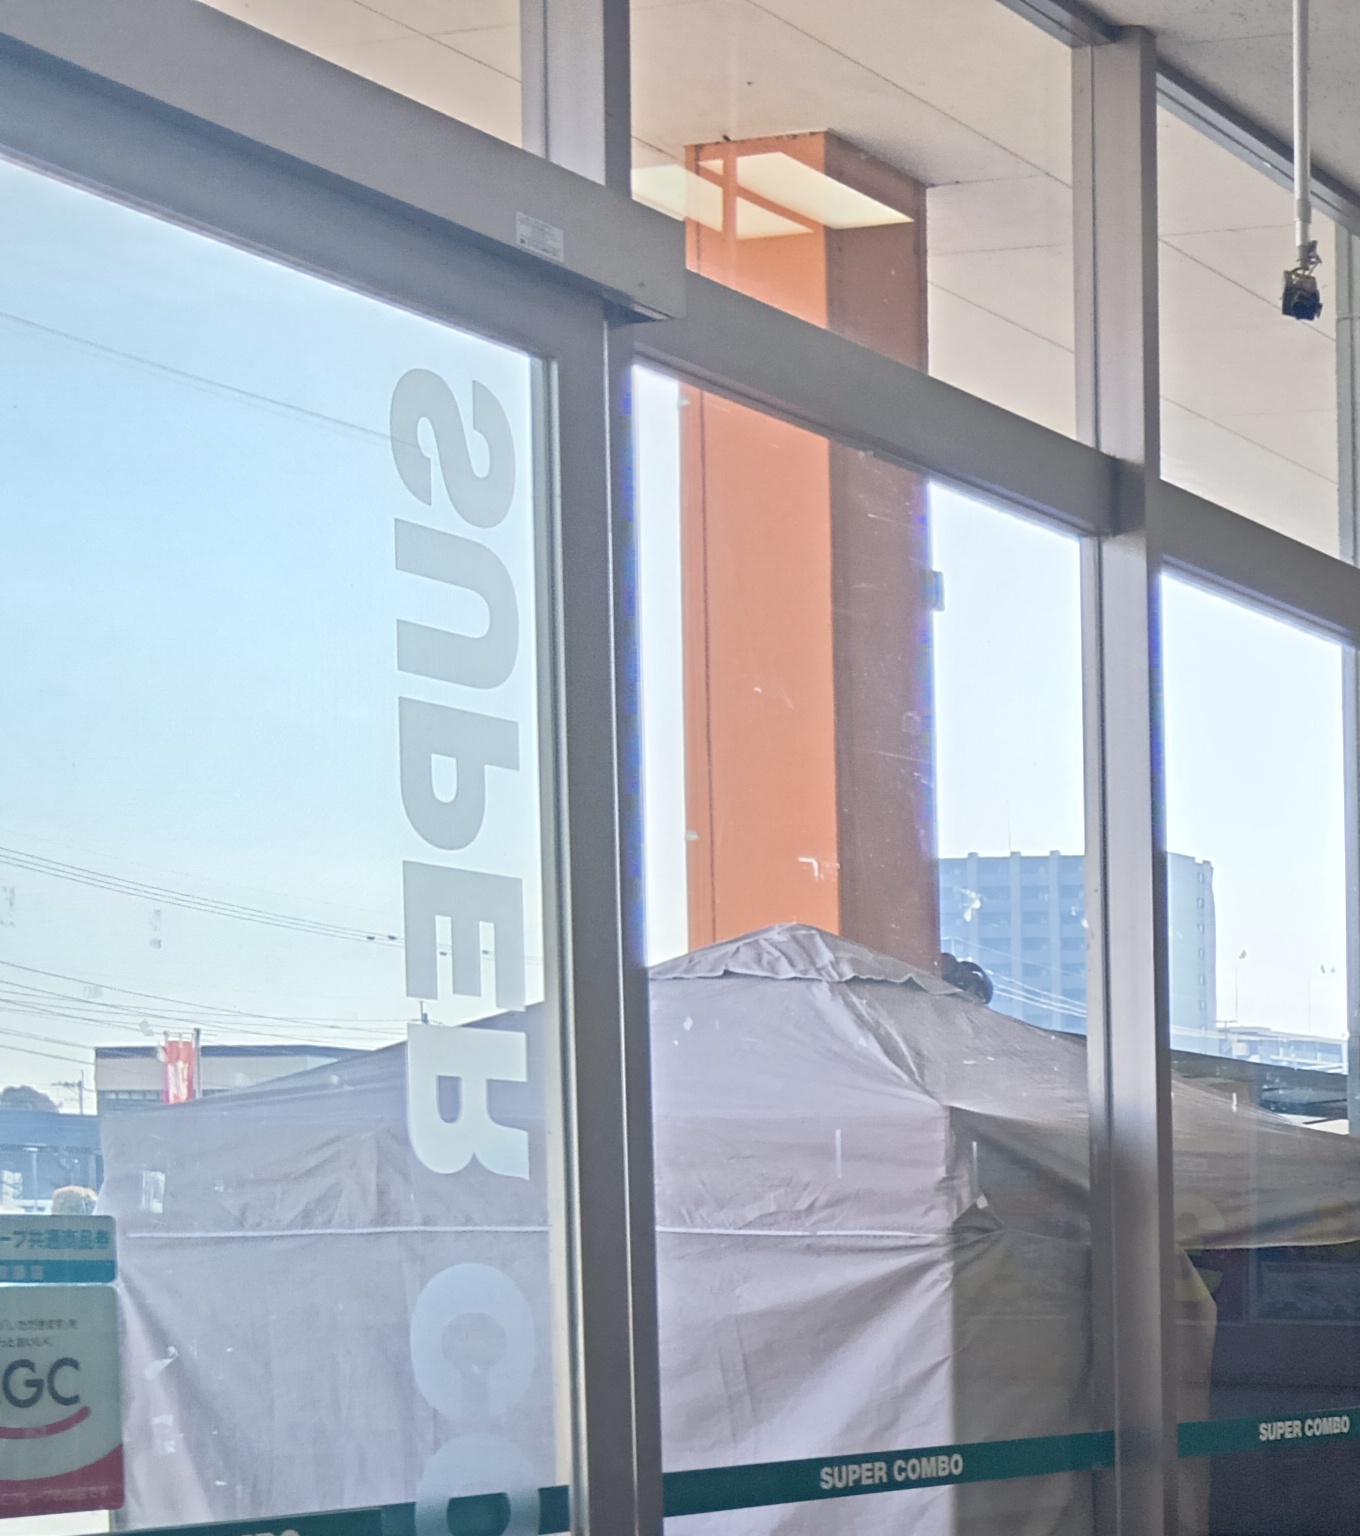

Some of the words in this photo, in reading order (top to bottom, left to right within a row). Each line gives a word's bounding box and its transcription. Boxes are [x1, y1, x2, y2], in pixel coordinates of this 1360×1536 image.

[1259, 1419, 1301, 1442] SUPER
[1304, 1414, 1350, 1439] COMBO
[820, 1460, 888, 1490] SUPER
[893, 1454, 964, 1484] COMBO
